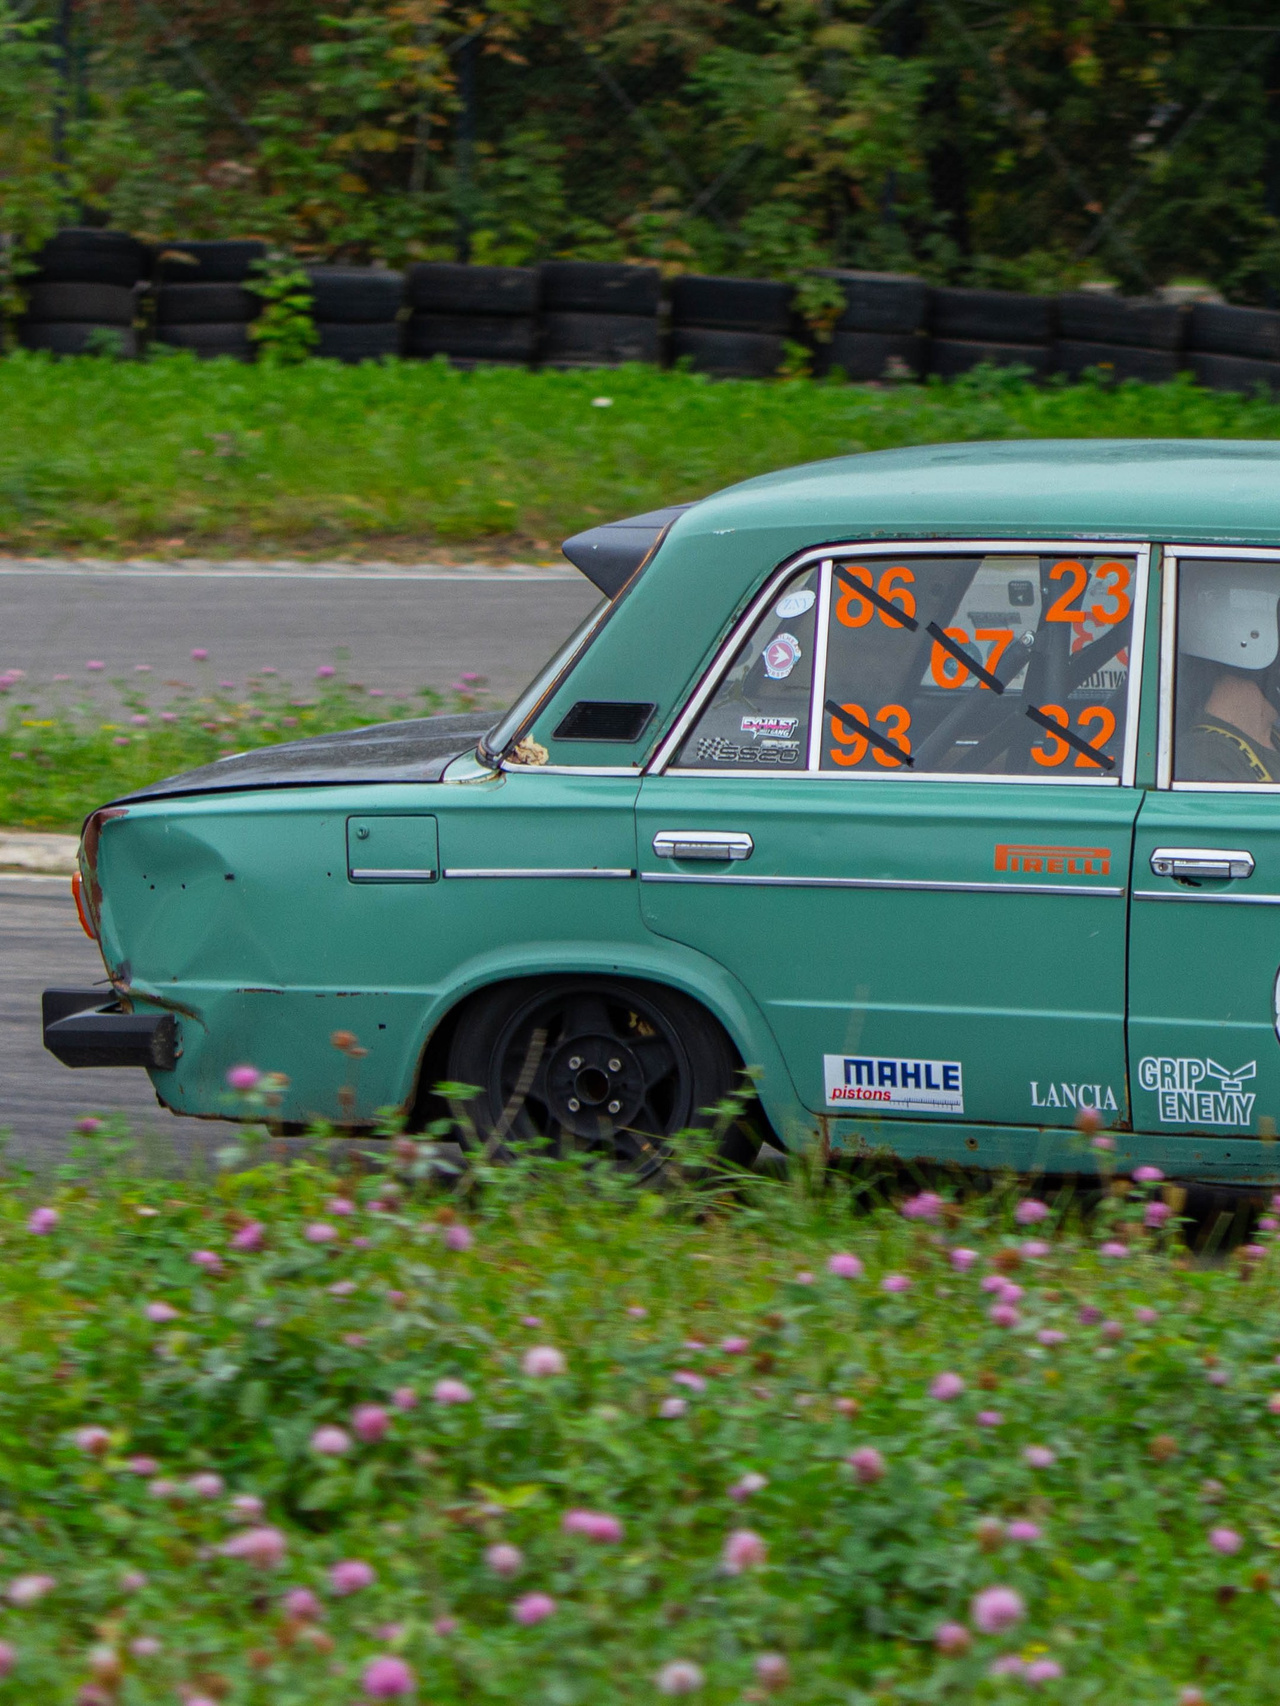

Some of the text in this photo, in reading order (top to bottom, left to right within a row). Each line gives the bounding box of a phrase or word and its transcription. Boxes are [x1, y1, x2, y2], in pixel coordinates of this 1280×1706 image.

[836, 566, 916, 628] 86
[1046, 561, 1131, 624] 23
[931, 627, 1014, 690] 67
[831, 704, 911, 767] 93
[1031, 704, 1116, 768] 32
[717, 746, 800, 763] SS20
[995, 845, 1111, 875] PIRELLI
[844, 1059, 960, 1091] MAHLE
[1139, 1057, 1206, 1092] GRIP
[831, 1086, 892, 1101] pistons
[1030, 1081, 1118, 1111] LANCIA
[1159, 1090, 1256, 1126] ENEMY
